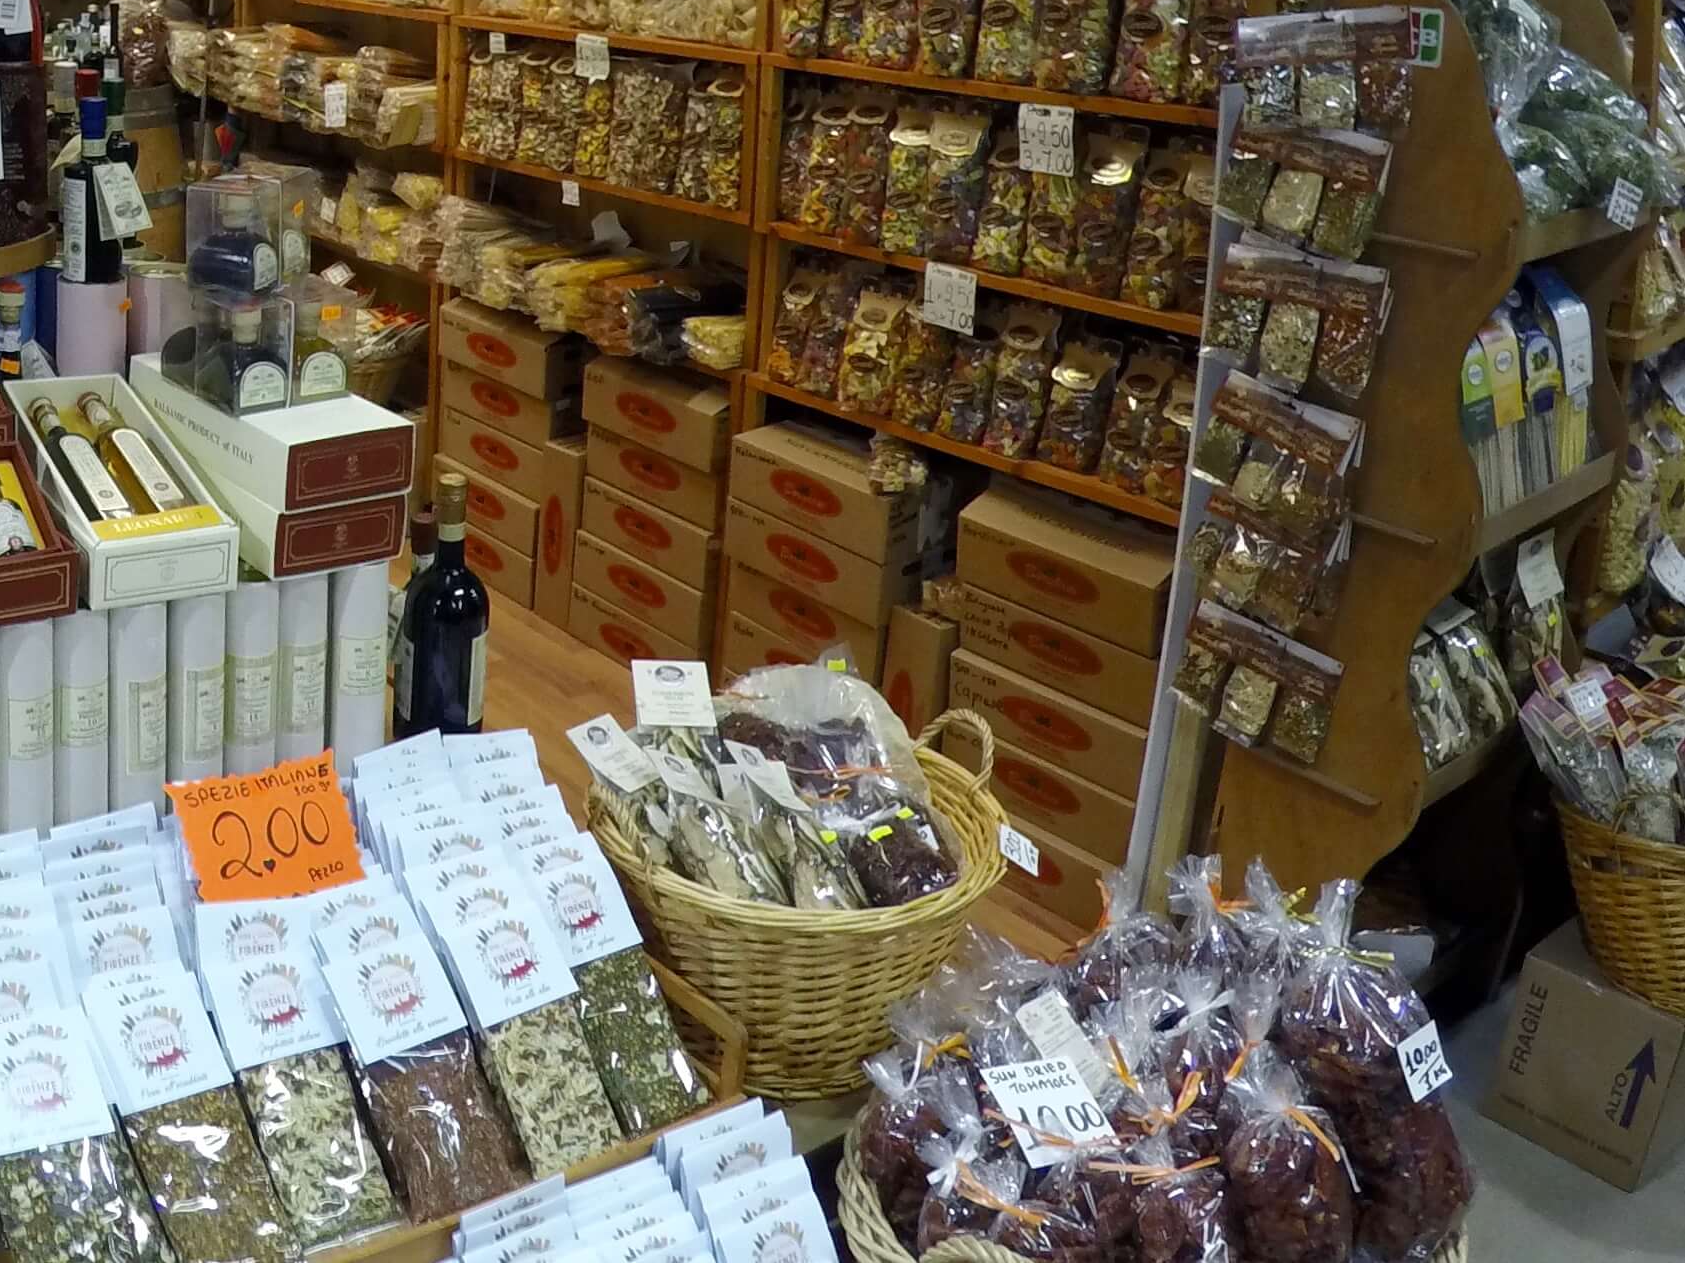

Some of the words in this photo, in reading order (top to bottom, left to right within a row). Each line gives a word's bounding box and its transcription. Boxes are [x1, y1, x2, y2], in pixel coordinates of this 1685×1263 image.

[184, 783, 251, 809] SPEZIE
[253, 763, 329, 793] ITALIANE
[212, 801, 330, 880] 2.00
[238, 943, 276, 956] FIRENZE
[103, 953, 141, 971] FIRENZE
[256, 993, 292, 1010] FIRENZE
[376, 981, 412, 1001] FIRENZE
[1508, 983, 1549, 1076] FRAGILE
[138, 1034, 175, 1052] FIRENZE
[988, 1067, 1016, 1085] SUN
[1024, 1061, 1067, 1078] DRIED
[1008, 1074, 1077, 1095] TOMATOES
[1604, 1071, 1629, 1123] ALTO
[1017, 1101, 1106, 1151] 1000
